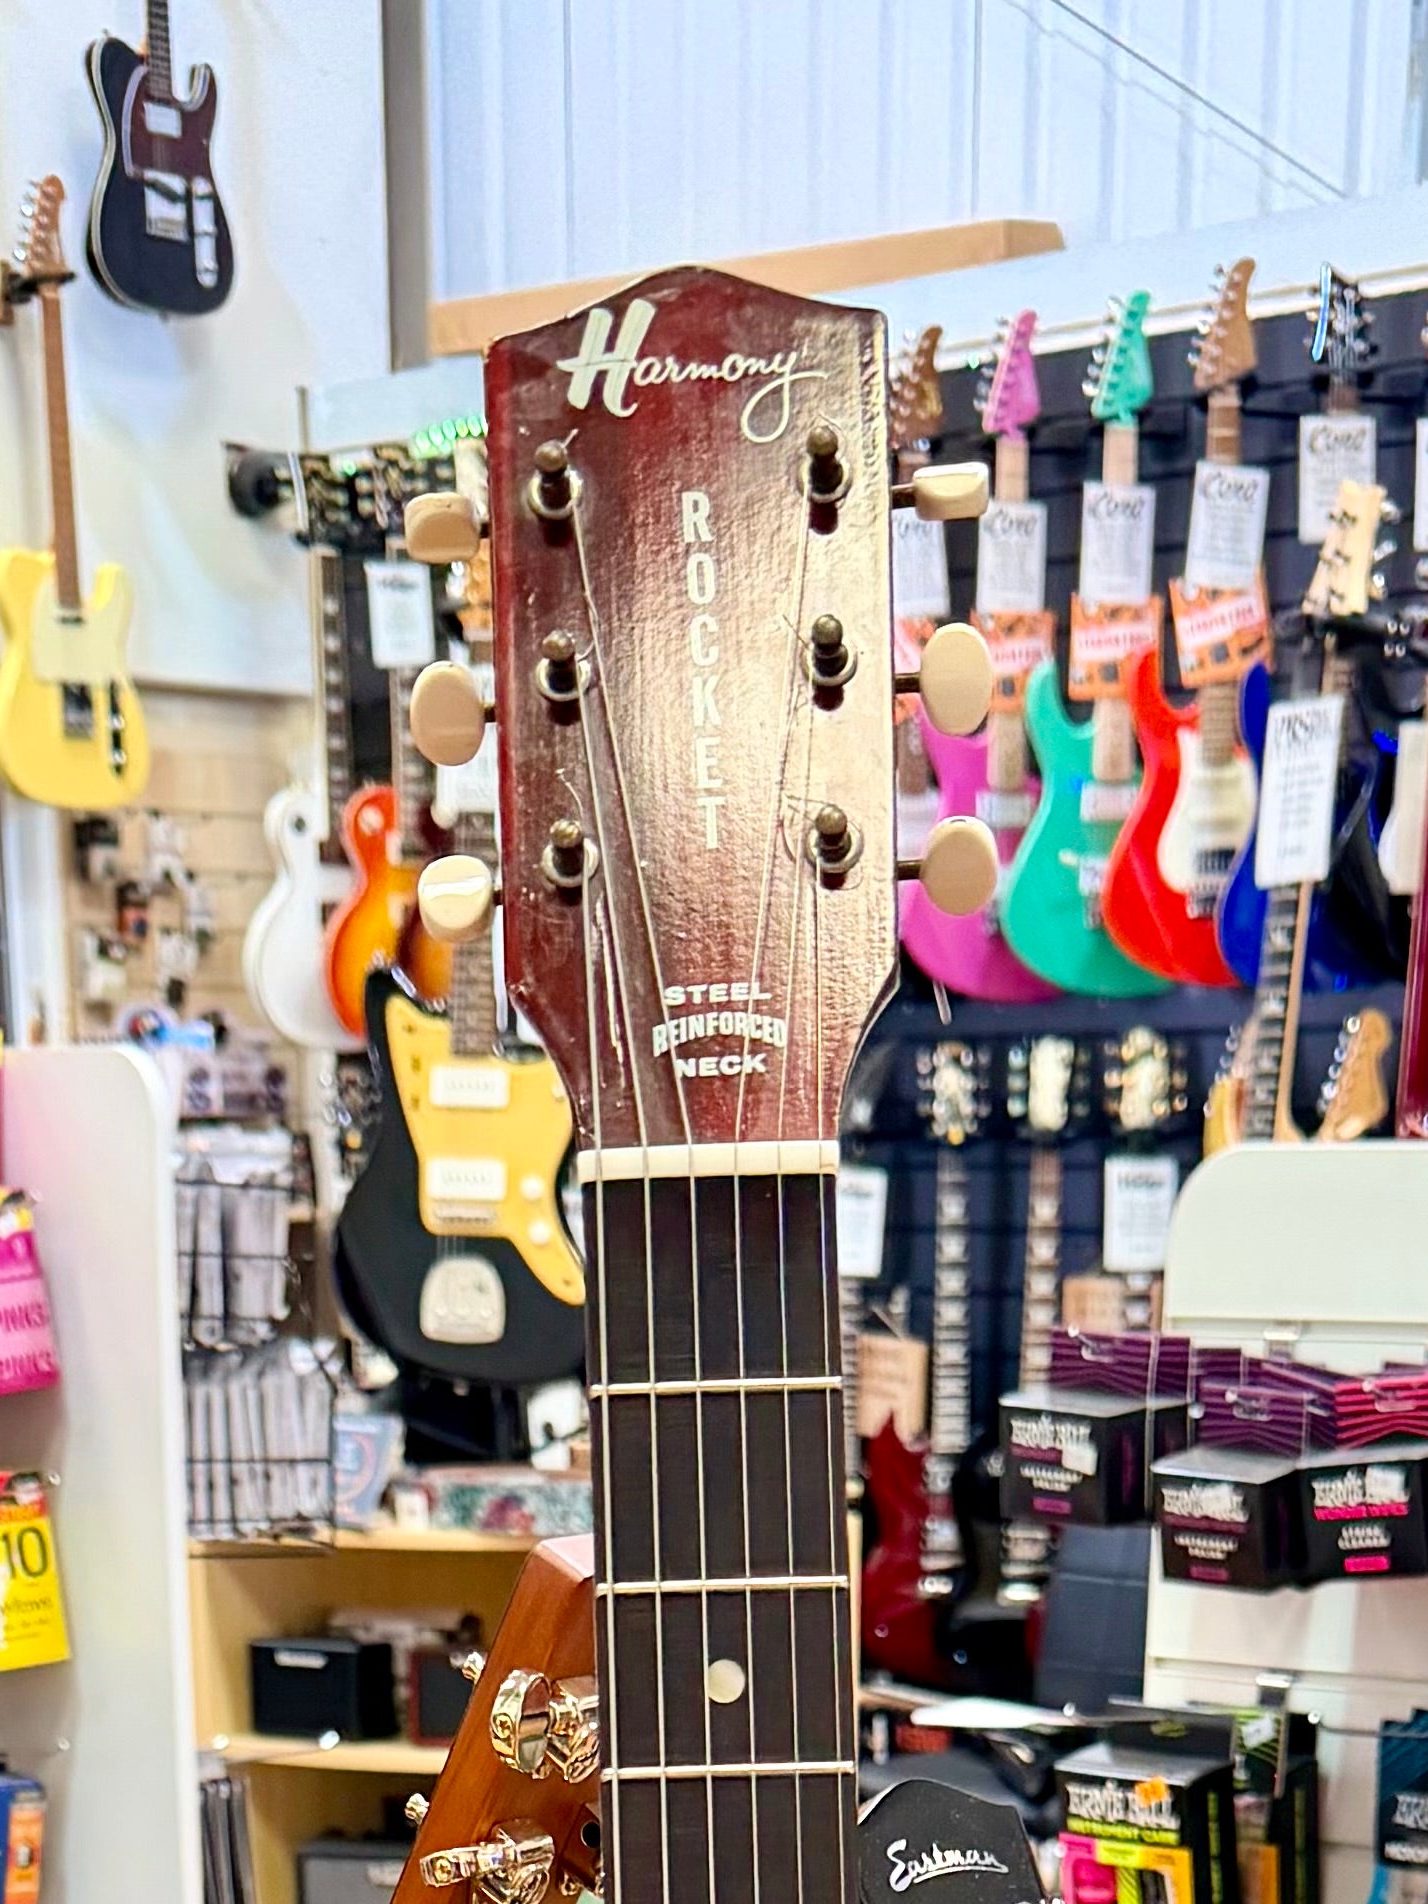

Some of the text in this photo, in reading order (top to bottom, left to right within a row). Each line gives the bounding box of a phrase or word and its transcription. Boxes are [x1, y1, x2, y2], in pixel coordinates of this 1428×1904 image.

[557, 299, 828, 443] Harmony
[681, 491, 727, 849] ROCKET
[662, 982, 773, 1008] STEEL
[651, 1011, 788, 1058] REINFORCED
[675, 1054, 767, 1078] NECK
[1, 1526, 48, 1579] 10
[886, 1838, 1009, 1892] Eastman
